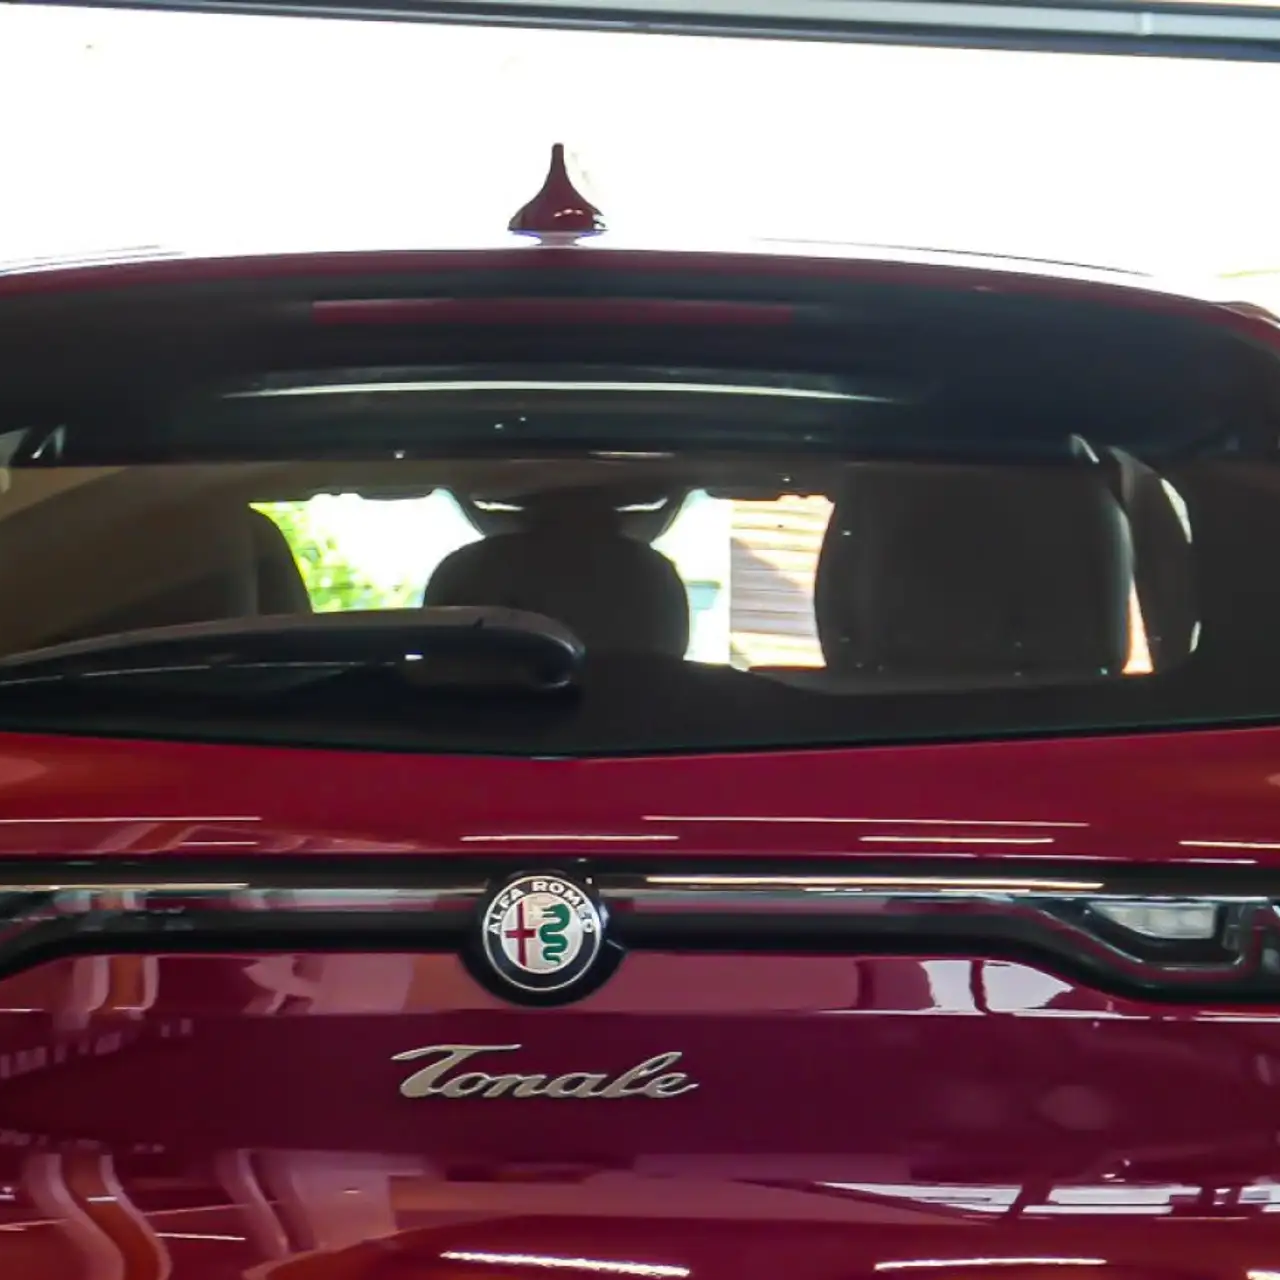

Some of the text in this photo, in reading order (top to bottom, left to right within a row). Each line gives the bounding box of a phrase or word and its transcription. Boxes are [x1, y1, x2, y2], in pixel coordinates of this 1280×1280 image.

[488, 880, 596, 935] ALFA ROMEO
[391, 1043, 700, 1098] Tonale
